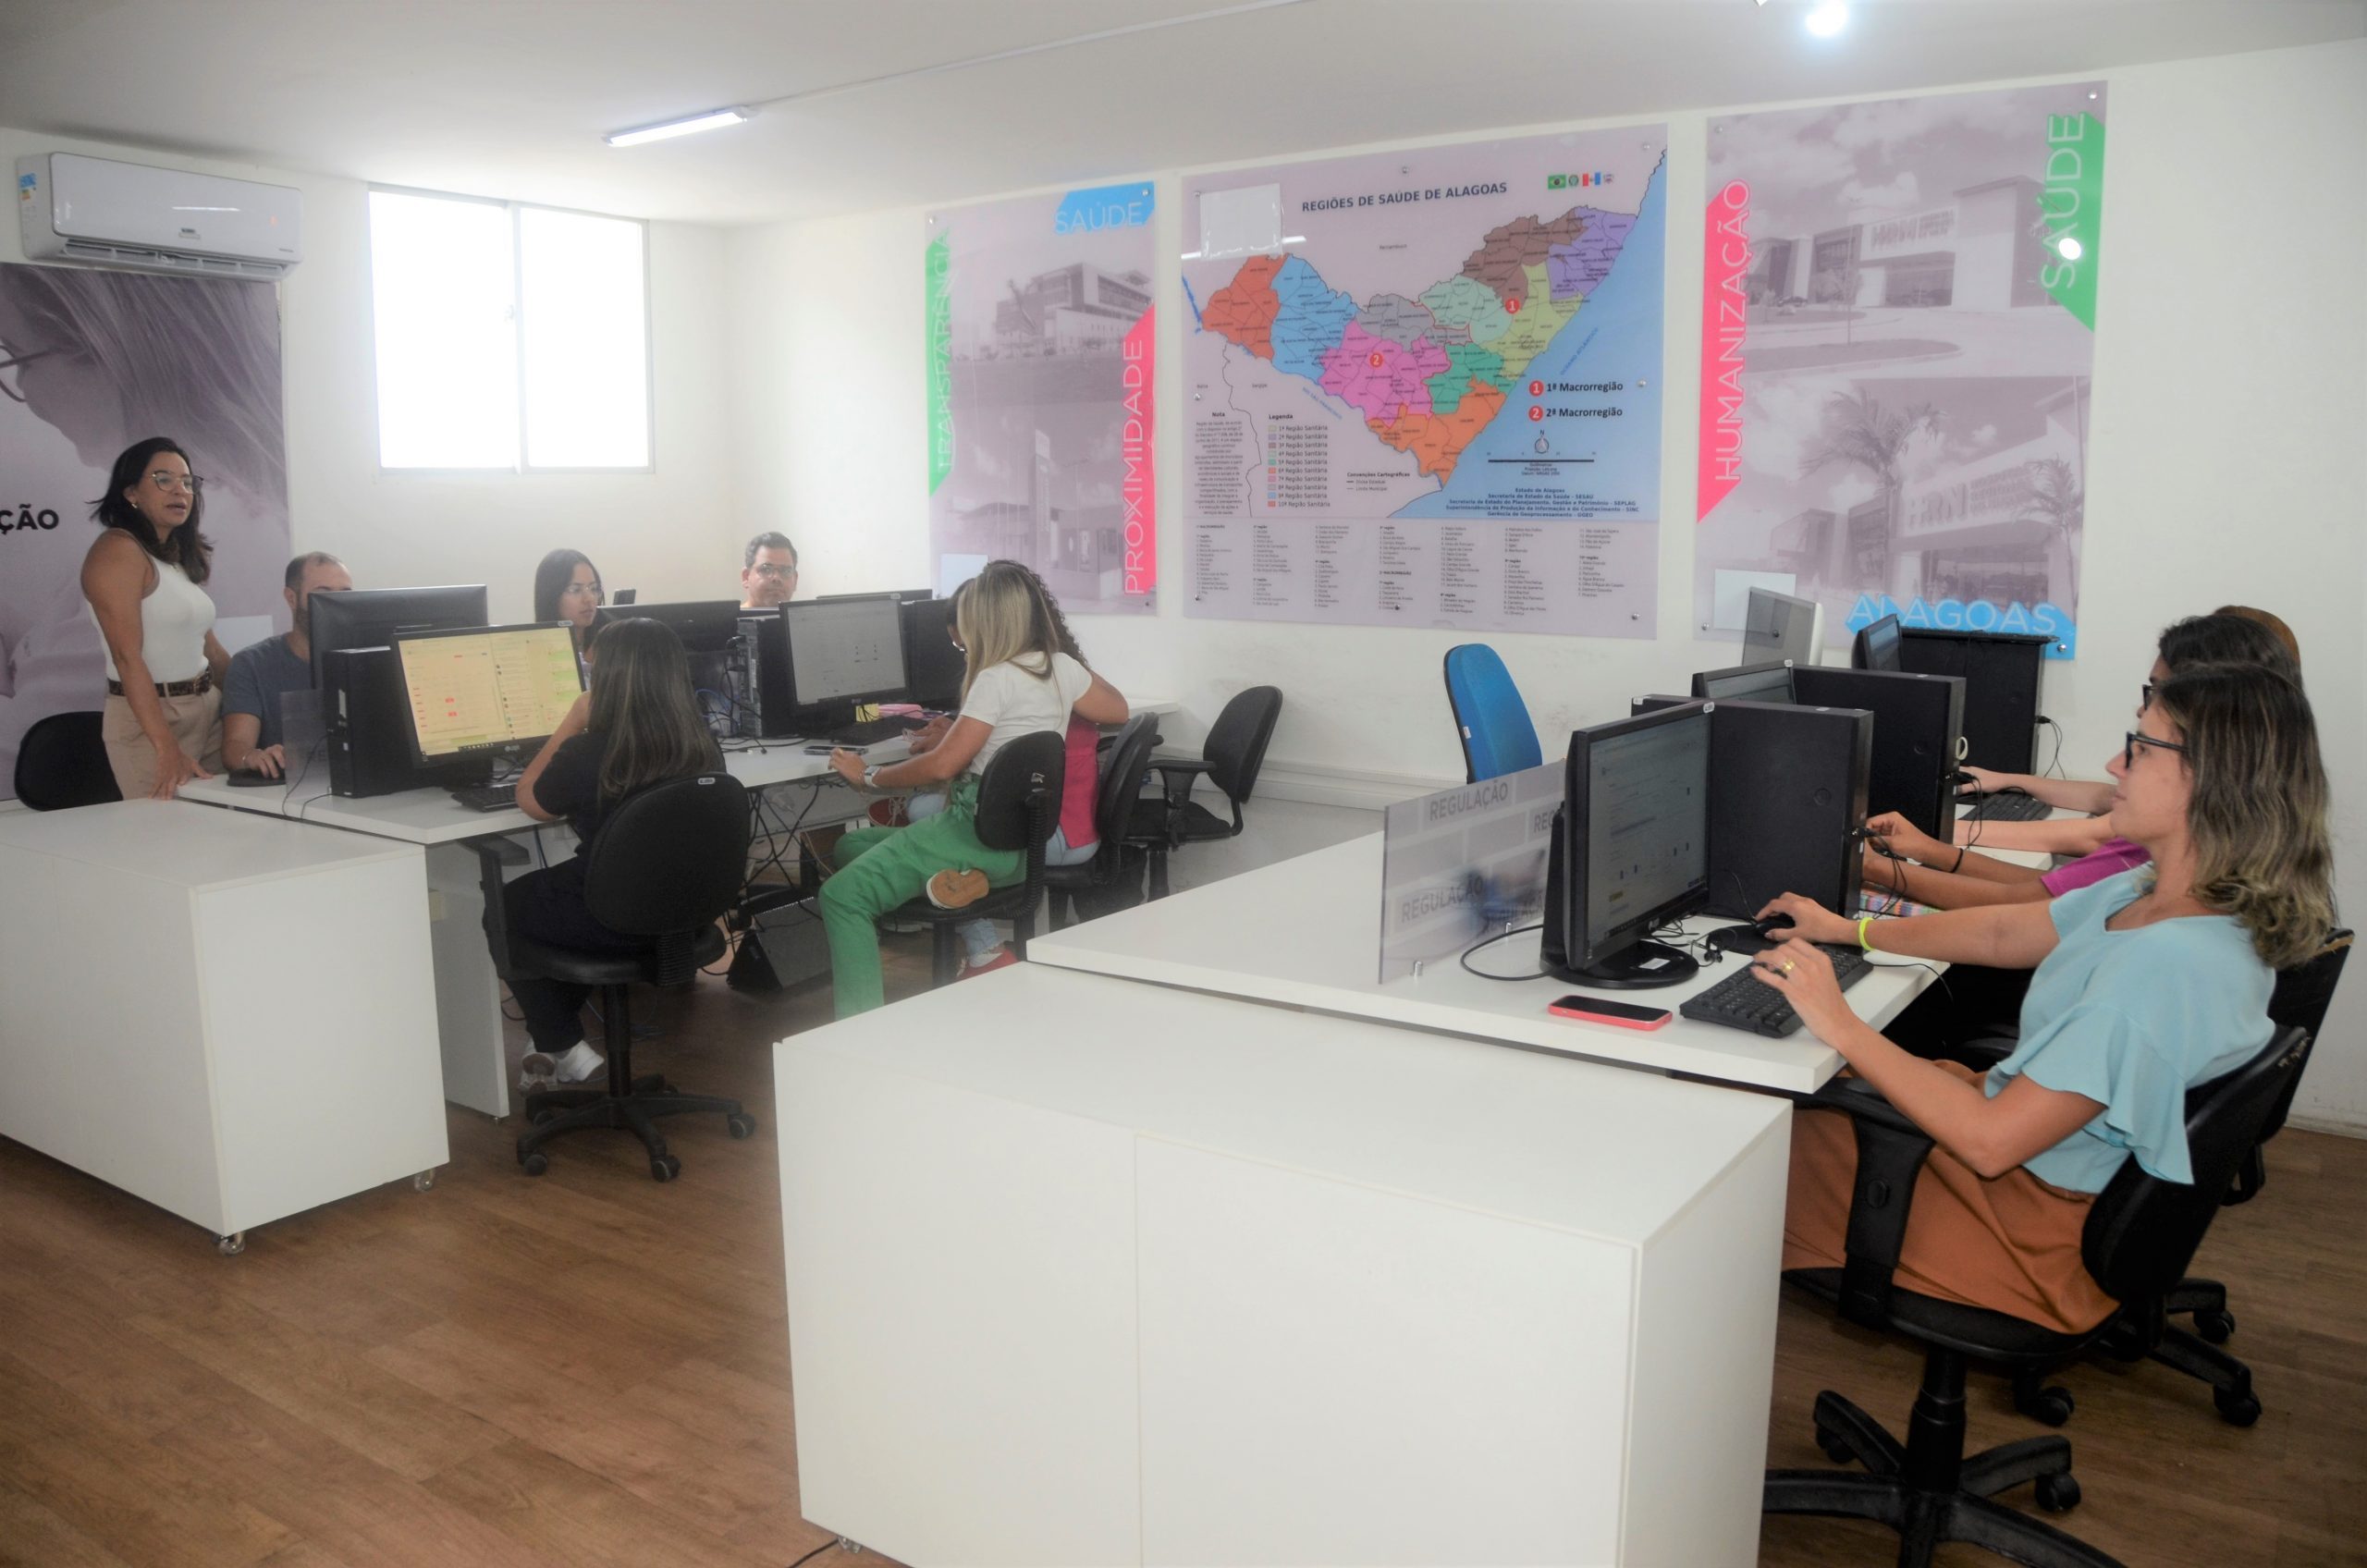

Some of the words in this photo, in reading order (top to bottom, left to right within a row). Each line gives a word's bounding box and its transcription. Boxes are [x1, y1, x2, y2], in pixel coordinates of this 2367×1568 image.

[1302, 196, 1354, 213] REGIÕES
[1358, 195, 1374, 206] DE
[1379, 190, 1420, 205] SAÚDE
[1424, 188, 1441, 200] DE
[1445, 182, 1507, 198] ALAGOAS
[2037, 113, 2084, 288] SAÚDE
[1055, 201, 1143, 235] SAÚDE
[1715, 180, 1752, 481] HUMANIZAÇÃO
[1560, 382, 1624, 393] Macrorregião
[1559, 407, 1623, 418] Macrorregião
[1122, 339, 1145, 594] PROXIMIDADE
[1285, 450, 1303, 459] Região
[1285, 459, 1303, 467] Região
[0, 503, 60, 536] ÇÃO
[1429, 779, 1508, 821] REGULAÇÃO
